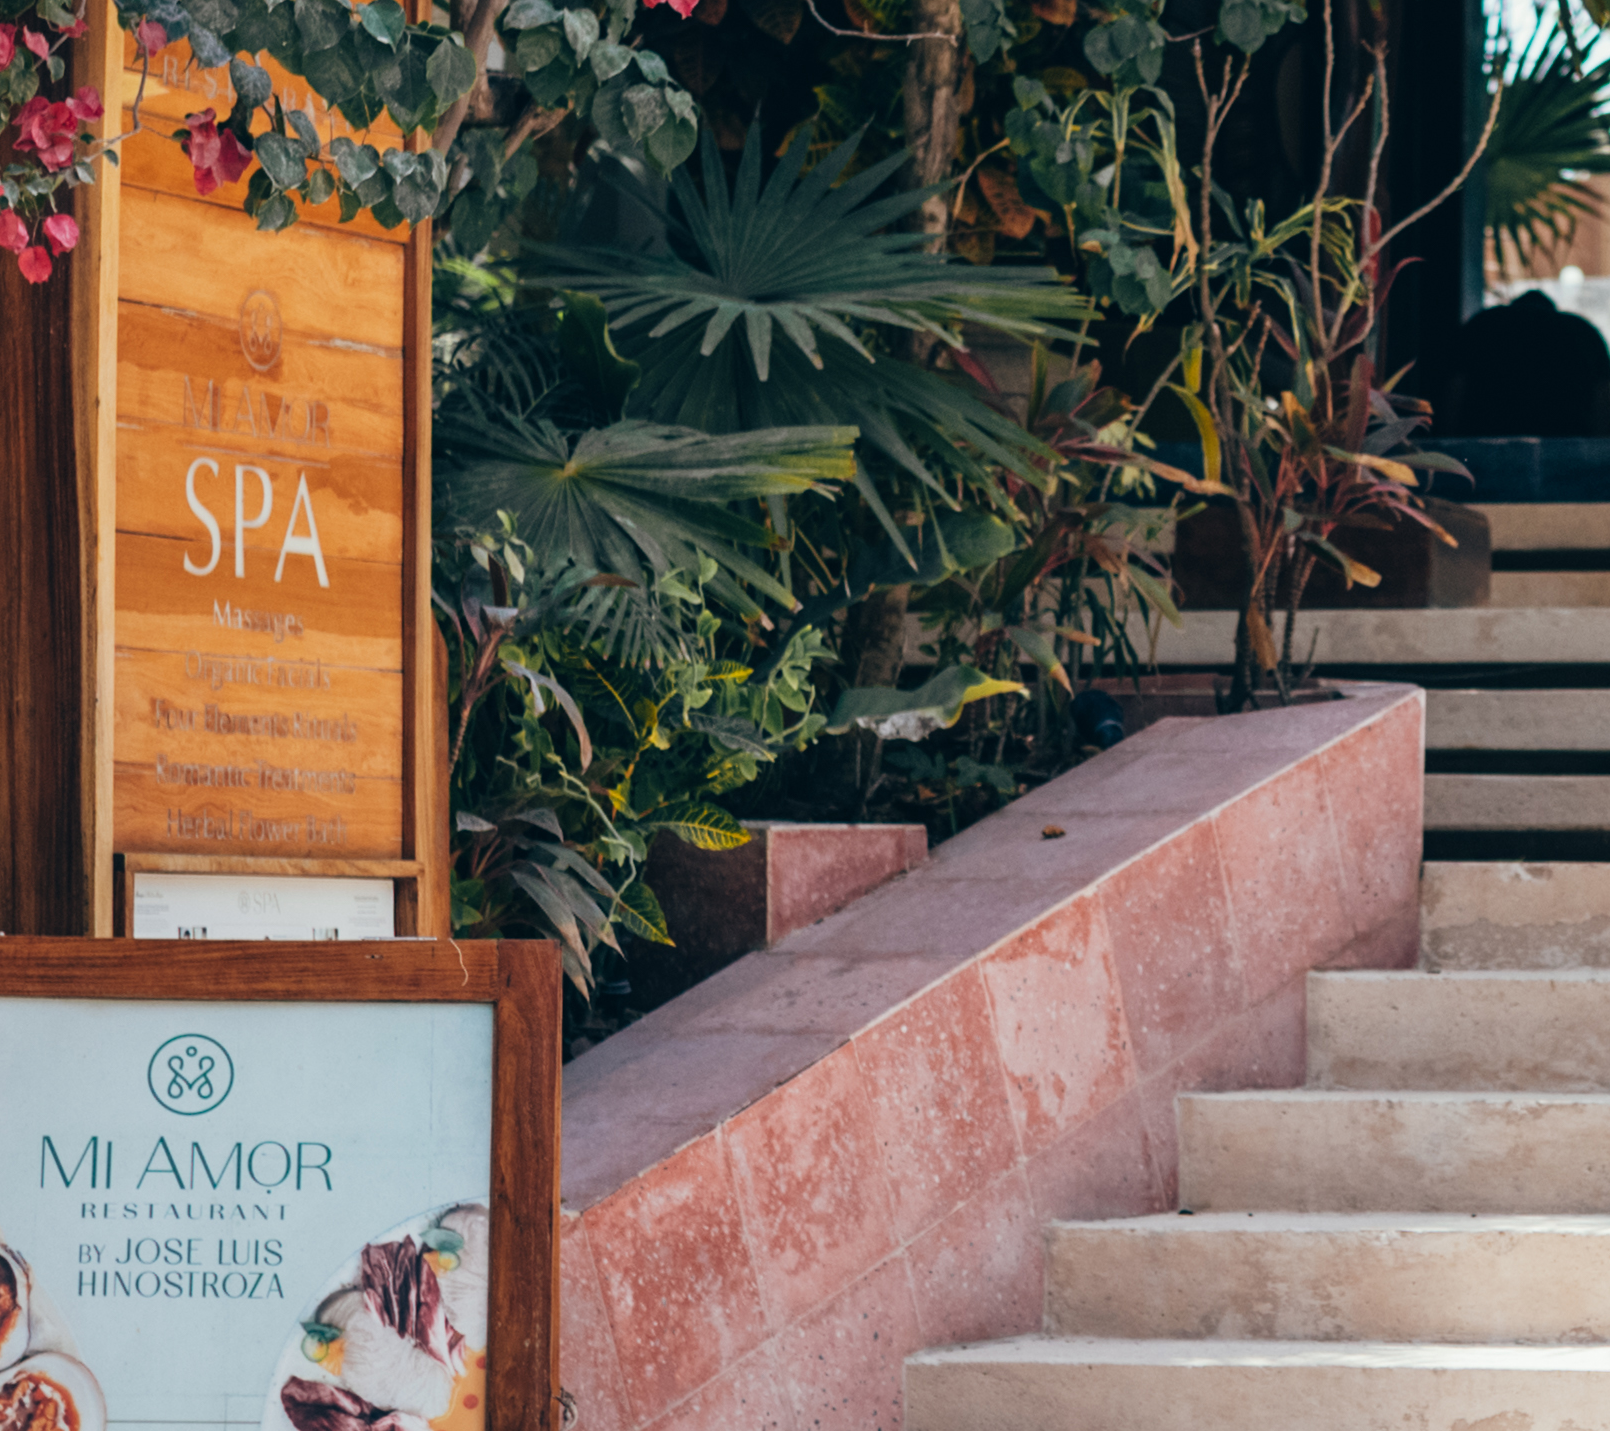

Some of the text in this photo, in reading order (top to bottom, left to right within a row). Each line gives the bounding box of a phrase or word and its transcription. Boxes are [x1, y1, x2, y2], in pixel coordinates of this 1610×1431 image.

[183, 373, 332, 448] MI AMOR
[183, 456, 330, 588] SPA
[212, 598, 305, 644] Massages
[185, 649, 331, 691] Organic Facials
[154, 698, 357, 743] Four Elements Rituals
[155, 753, 357, 795] Romantic Treatments
[166, 807, 348, 845] Herbal Flower Bath
[40, 1135, 332, 1194] MI AMOR
[81, 1202, 290, 1220] RESTAURANT
[78, 1237, 283, 1266] BY JOSE LUIS
[78, 1270, 284, 1299] HINOSTROZA
